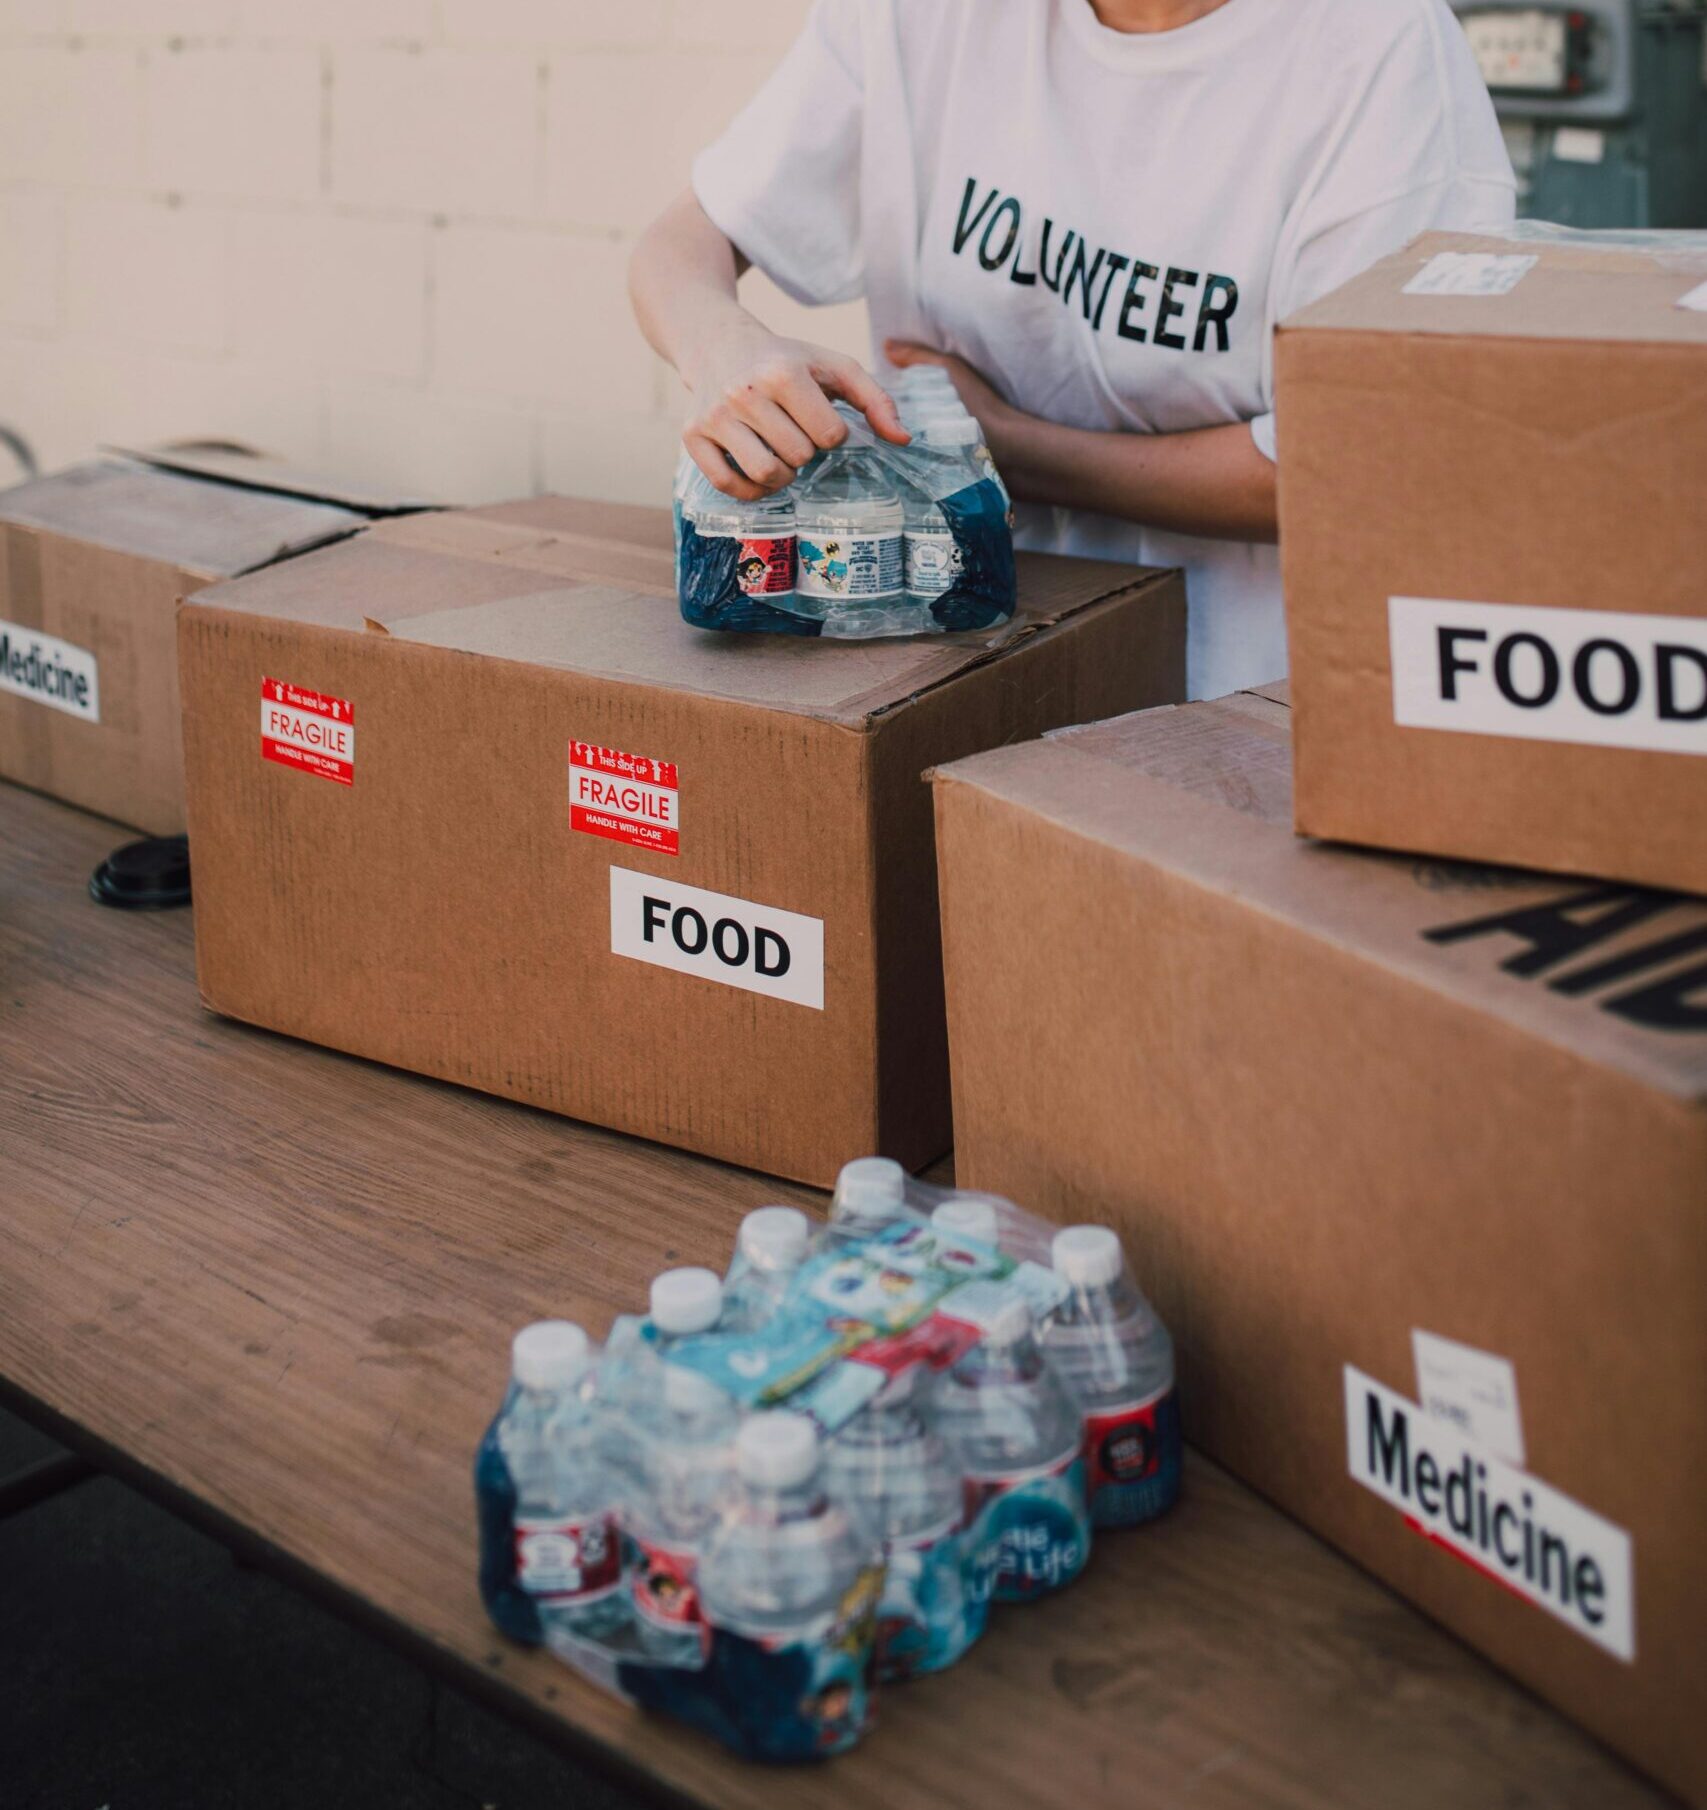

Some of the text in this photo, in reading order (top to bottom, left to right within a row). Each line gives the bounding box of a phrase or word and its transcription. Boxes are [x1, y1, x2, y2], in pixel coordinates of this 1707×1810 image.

[952, 177, 1239, 352] VOLUNTEER
[1436, 625, 1707, 721] FOOD
[270, 711, 347, 754] FRAGILE
[599, 756, 648, 776] THIS SIDE UP
[579, 776, 670, 821] FRAGILE
[585, 812, 663, 842] HANDLE WITH CARE
[642, 895, 791, 978] FOOD
[1365, 1390, 1606, 1627] Medicine
